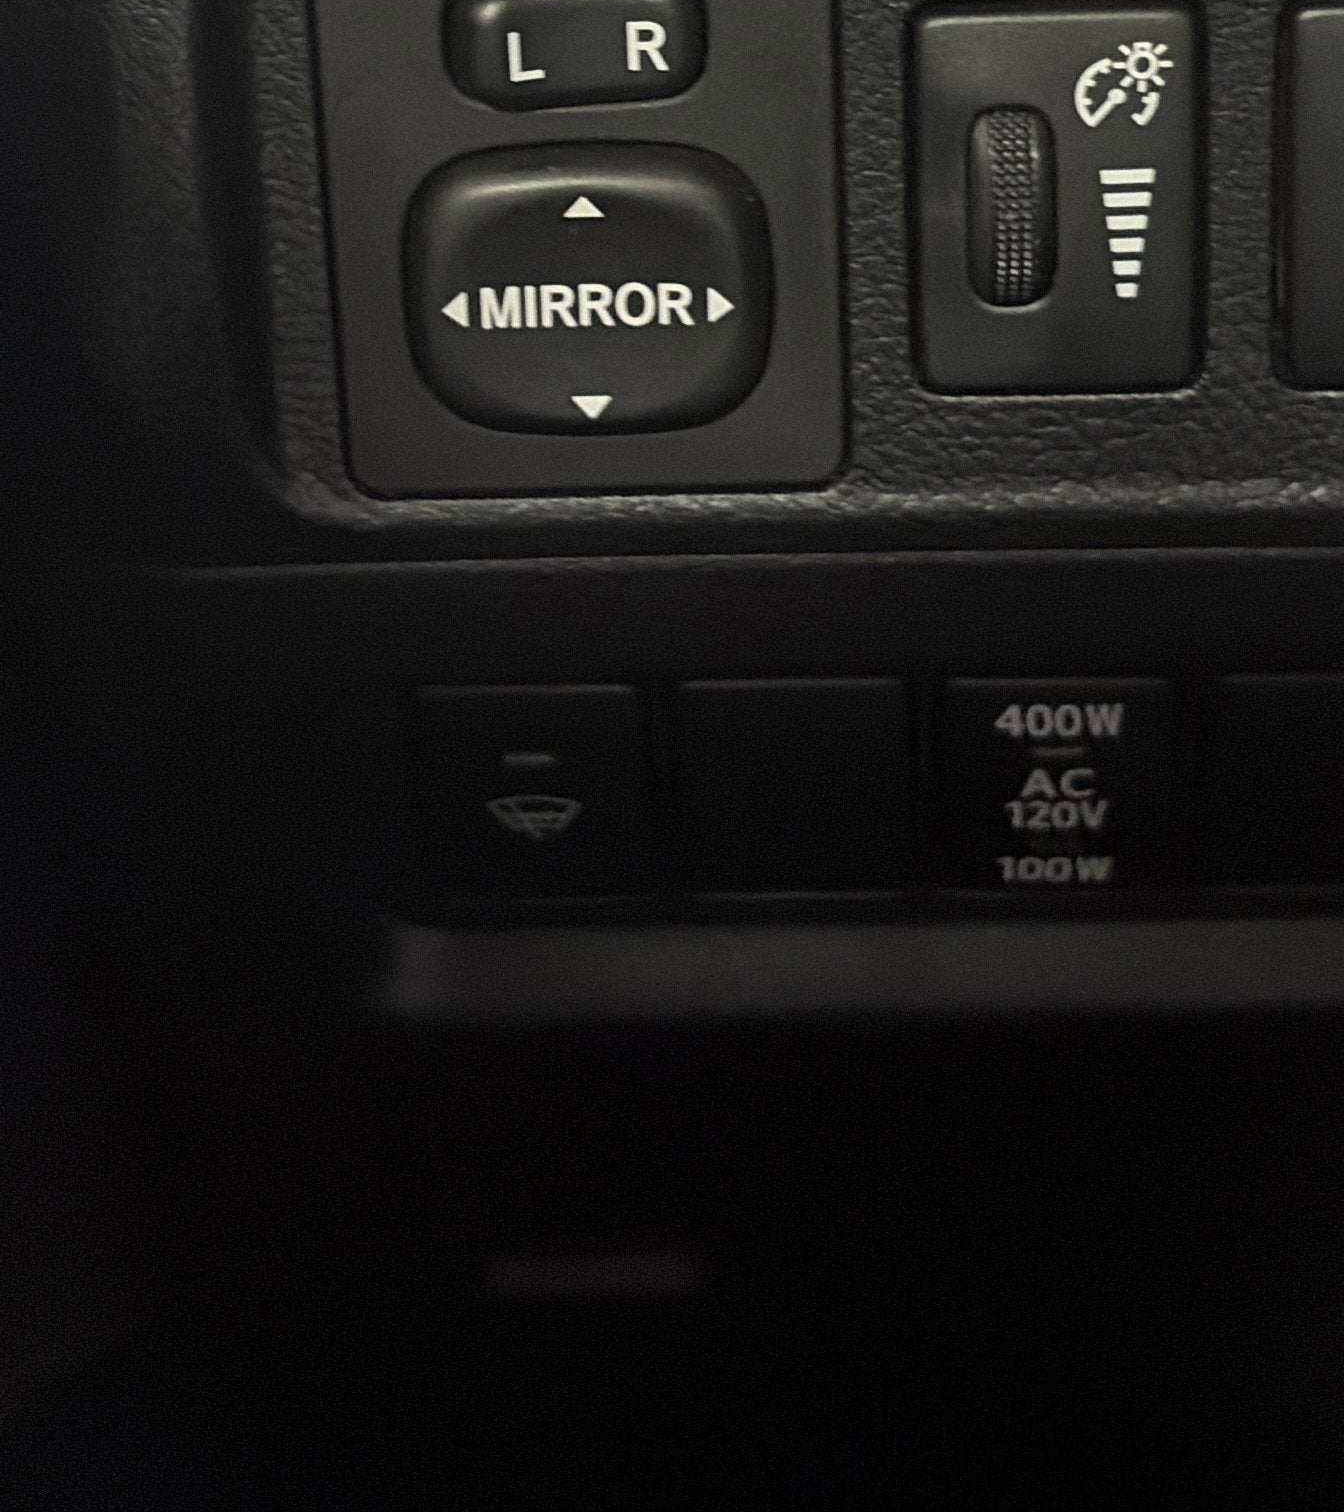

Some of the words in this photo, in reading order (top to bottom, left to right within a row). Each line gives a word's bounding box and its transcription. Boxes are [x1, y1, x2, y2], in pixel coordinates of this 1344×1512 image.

[507, 31, 546, 83] L
[625, 20, 669, 72] R
[479, 281, 696, 330] MIRROR
[994, 702, 1124, 738] 400W
[1021, 767, 1096, 799] AC
[1005, 799, 1109, 831] 120V
[996, 855, 1115, 884] 100W
